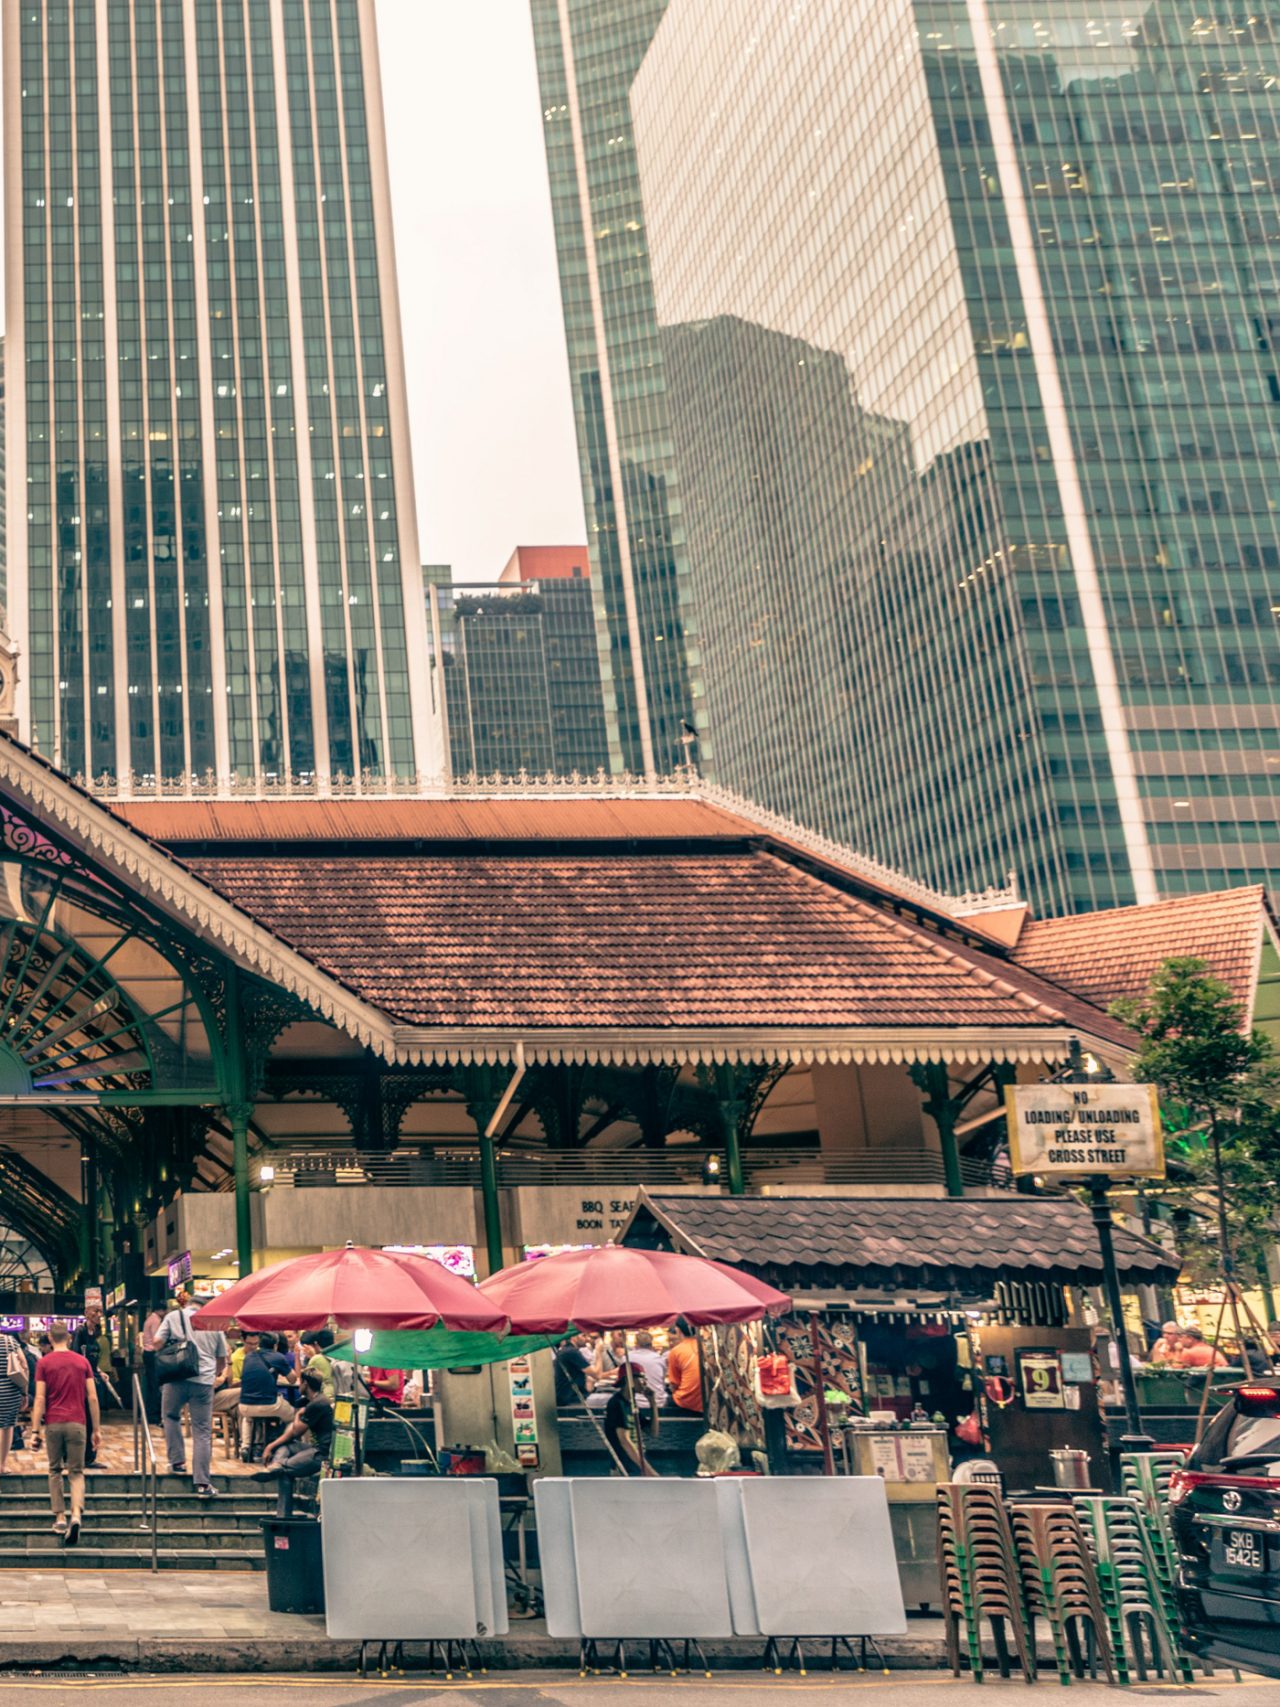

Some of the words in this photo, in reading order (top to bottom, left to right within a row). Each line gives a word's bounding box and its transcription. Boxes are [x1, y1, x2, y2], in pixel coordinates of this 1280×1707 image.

[1073, 1091, 1088, 1104] NO
[1024, 1110, 1075, 1124] LOADING/
[1078, 1110, 1140, 1124] UNLOADING
[1055, 1130, 1092, 1143] PLEASE
[1095, 1130, 1116, 1143] USE
[1048, 1149, 1085, 1163] CROSS
[1087, 1149, 1126, 1163] STREET
[582, 1201, 604, 1214] BBQ
[577, 1219, 602, 1229] BOON
[1031, 1368, 1050, 1392] 9
[1230, 1531, 1254, 1549] SKB
[1225, 1547, 1261, 1567] 1542E
